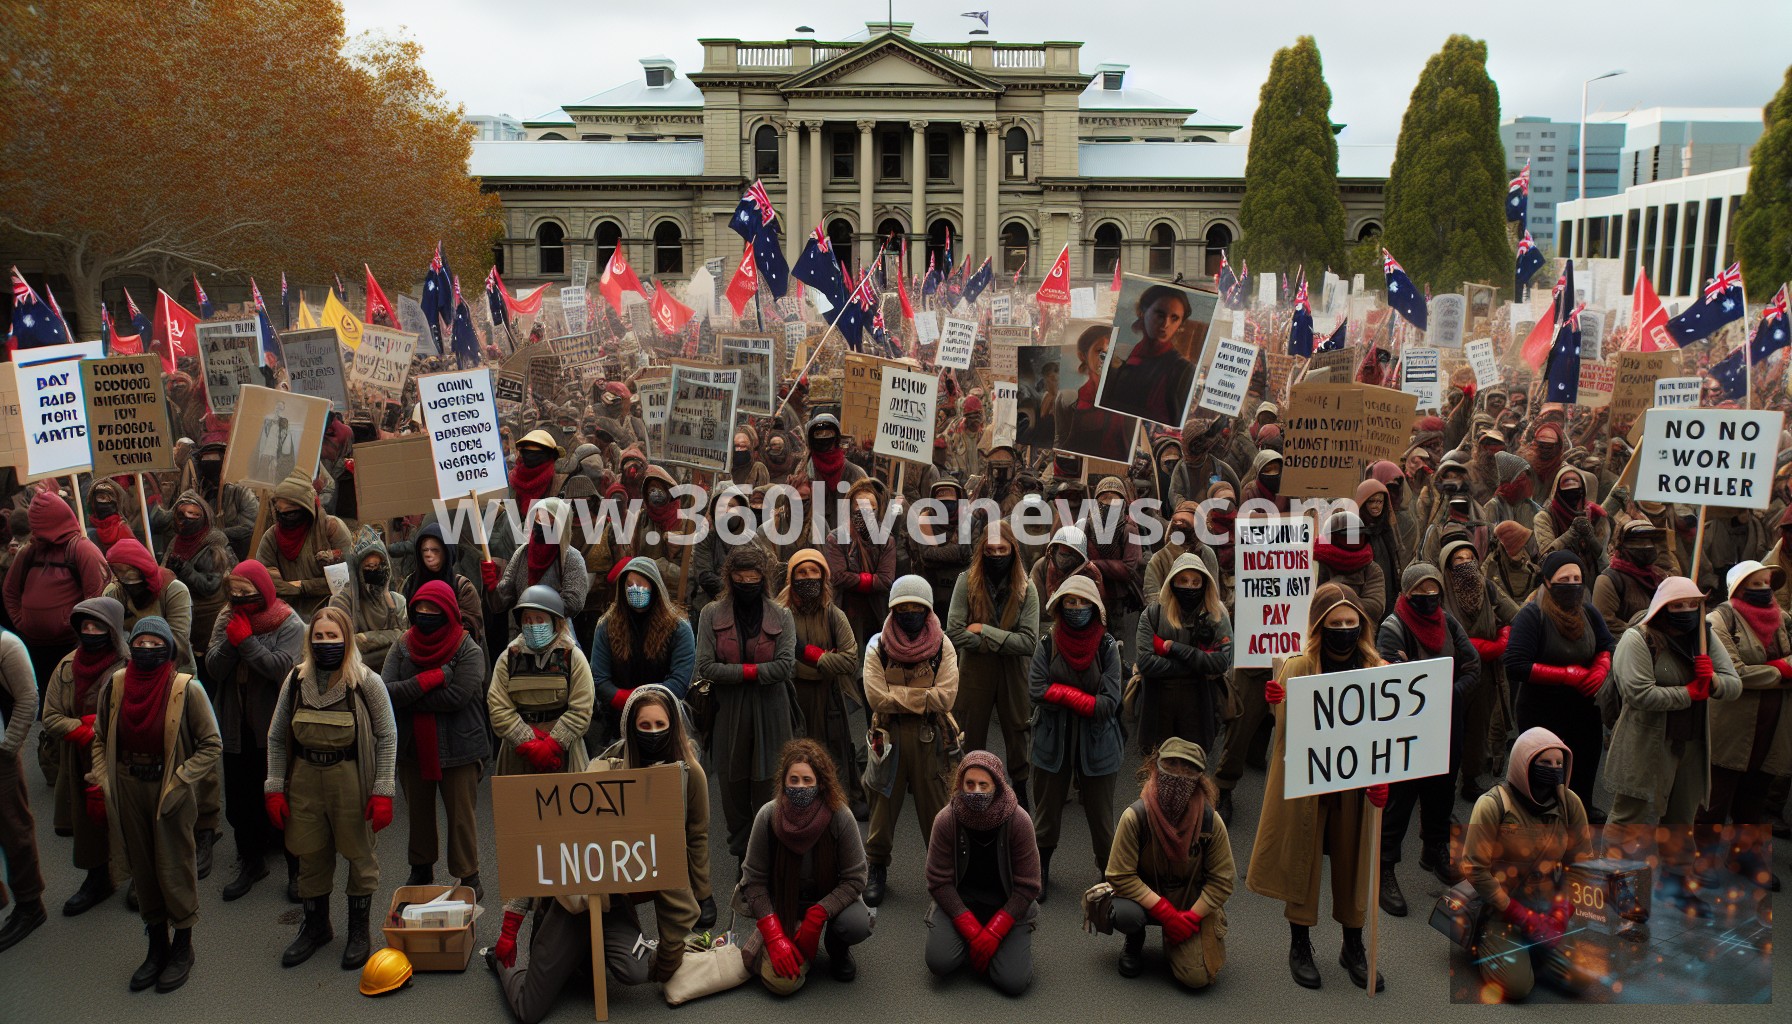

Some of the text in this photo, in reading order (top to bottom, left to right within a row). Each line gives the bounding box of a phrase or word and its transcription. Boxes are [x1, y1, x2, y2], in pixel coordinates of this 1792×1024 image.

[1665, 419, 1760, 441] NO NO
[1672, 448, 1731, 469] WOR
[1262, 603, 1291, 625] PAY
[1307, 735, 1418, 785] NO HT
[536, 833, 658, 886] LNORS!
